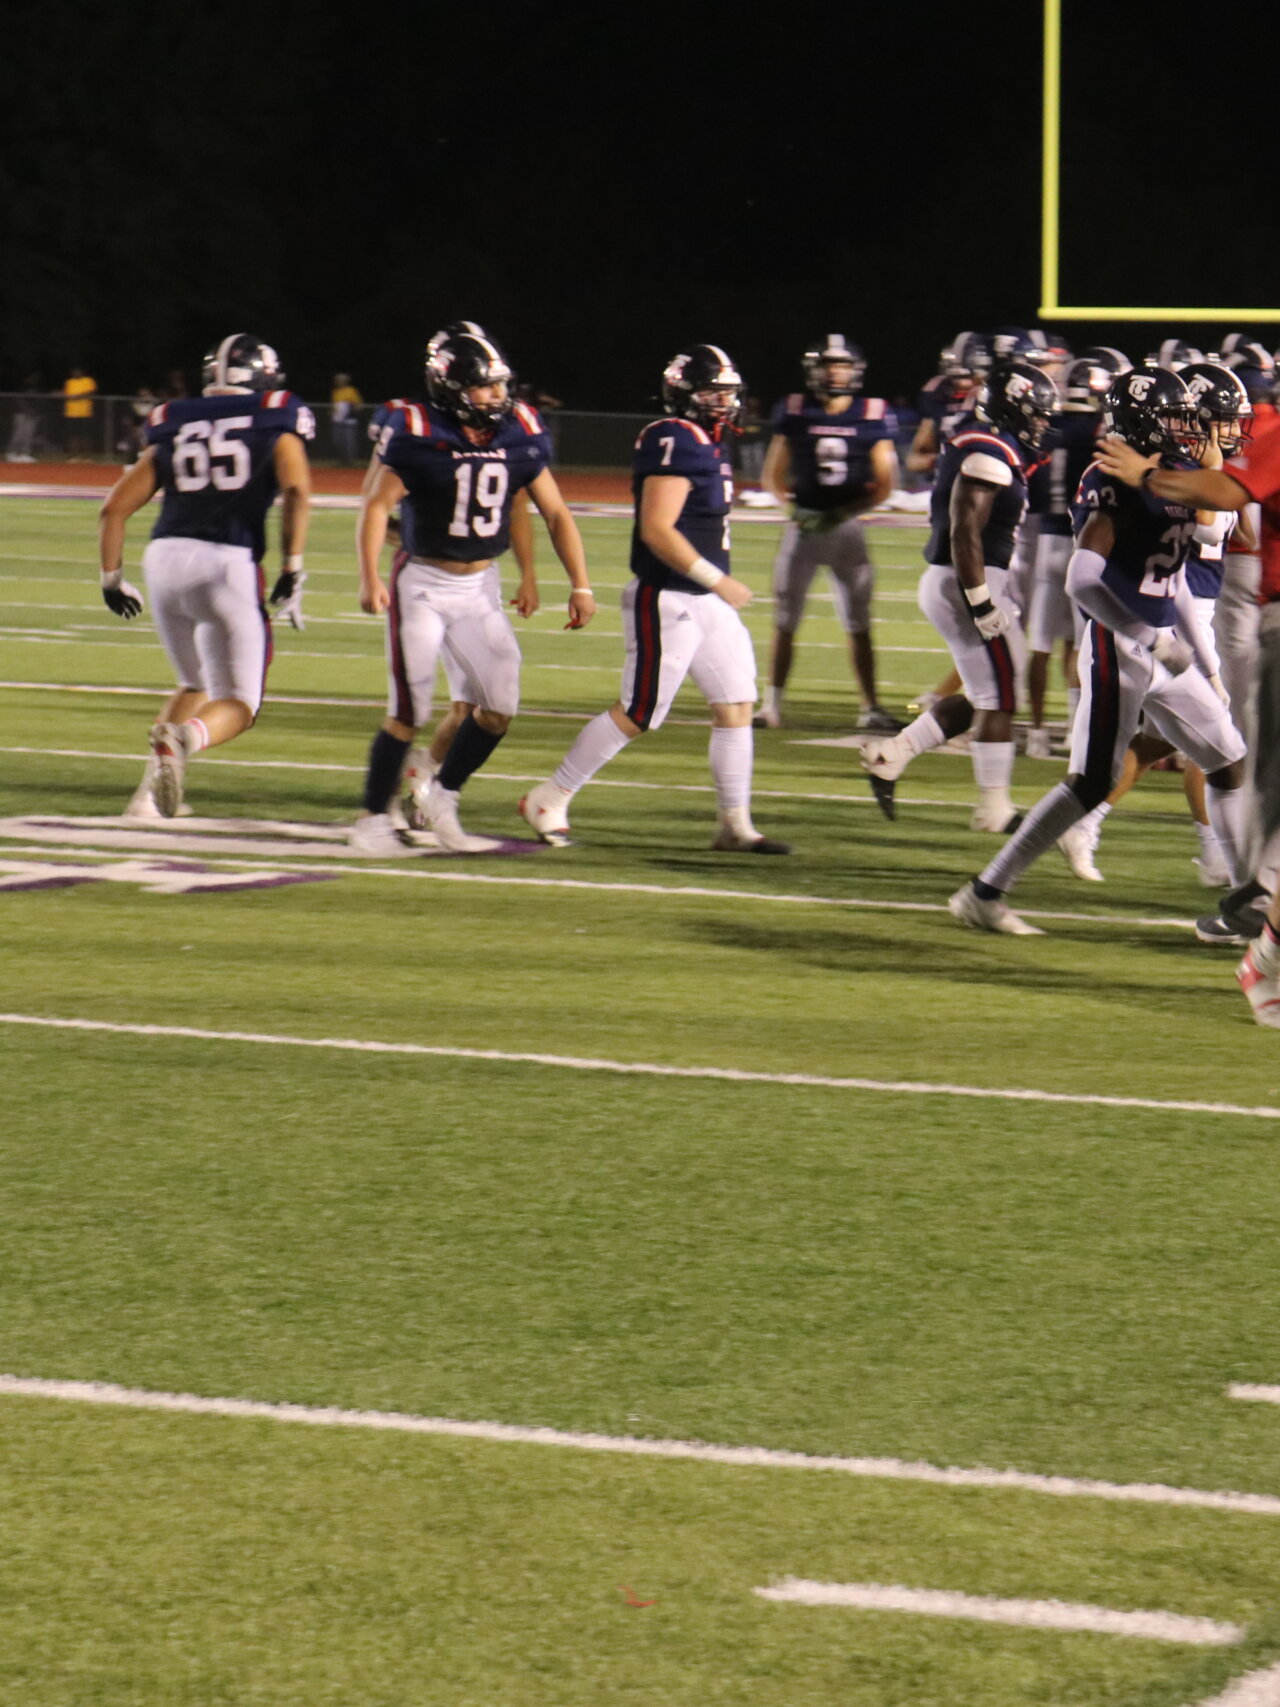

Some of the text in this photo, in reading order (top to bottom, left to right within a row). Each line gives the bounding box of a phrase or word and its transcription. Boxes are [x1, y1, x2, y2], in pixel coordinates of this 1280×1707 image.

[172, 415, 253, 492] 65
[659, 436, 675, 466] 7
[448, 462, 509, 538] 19
